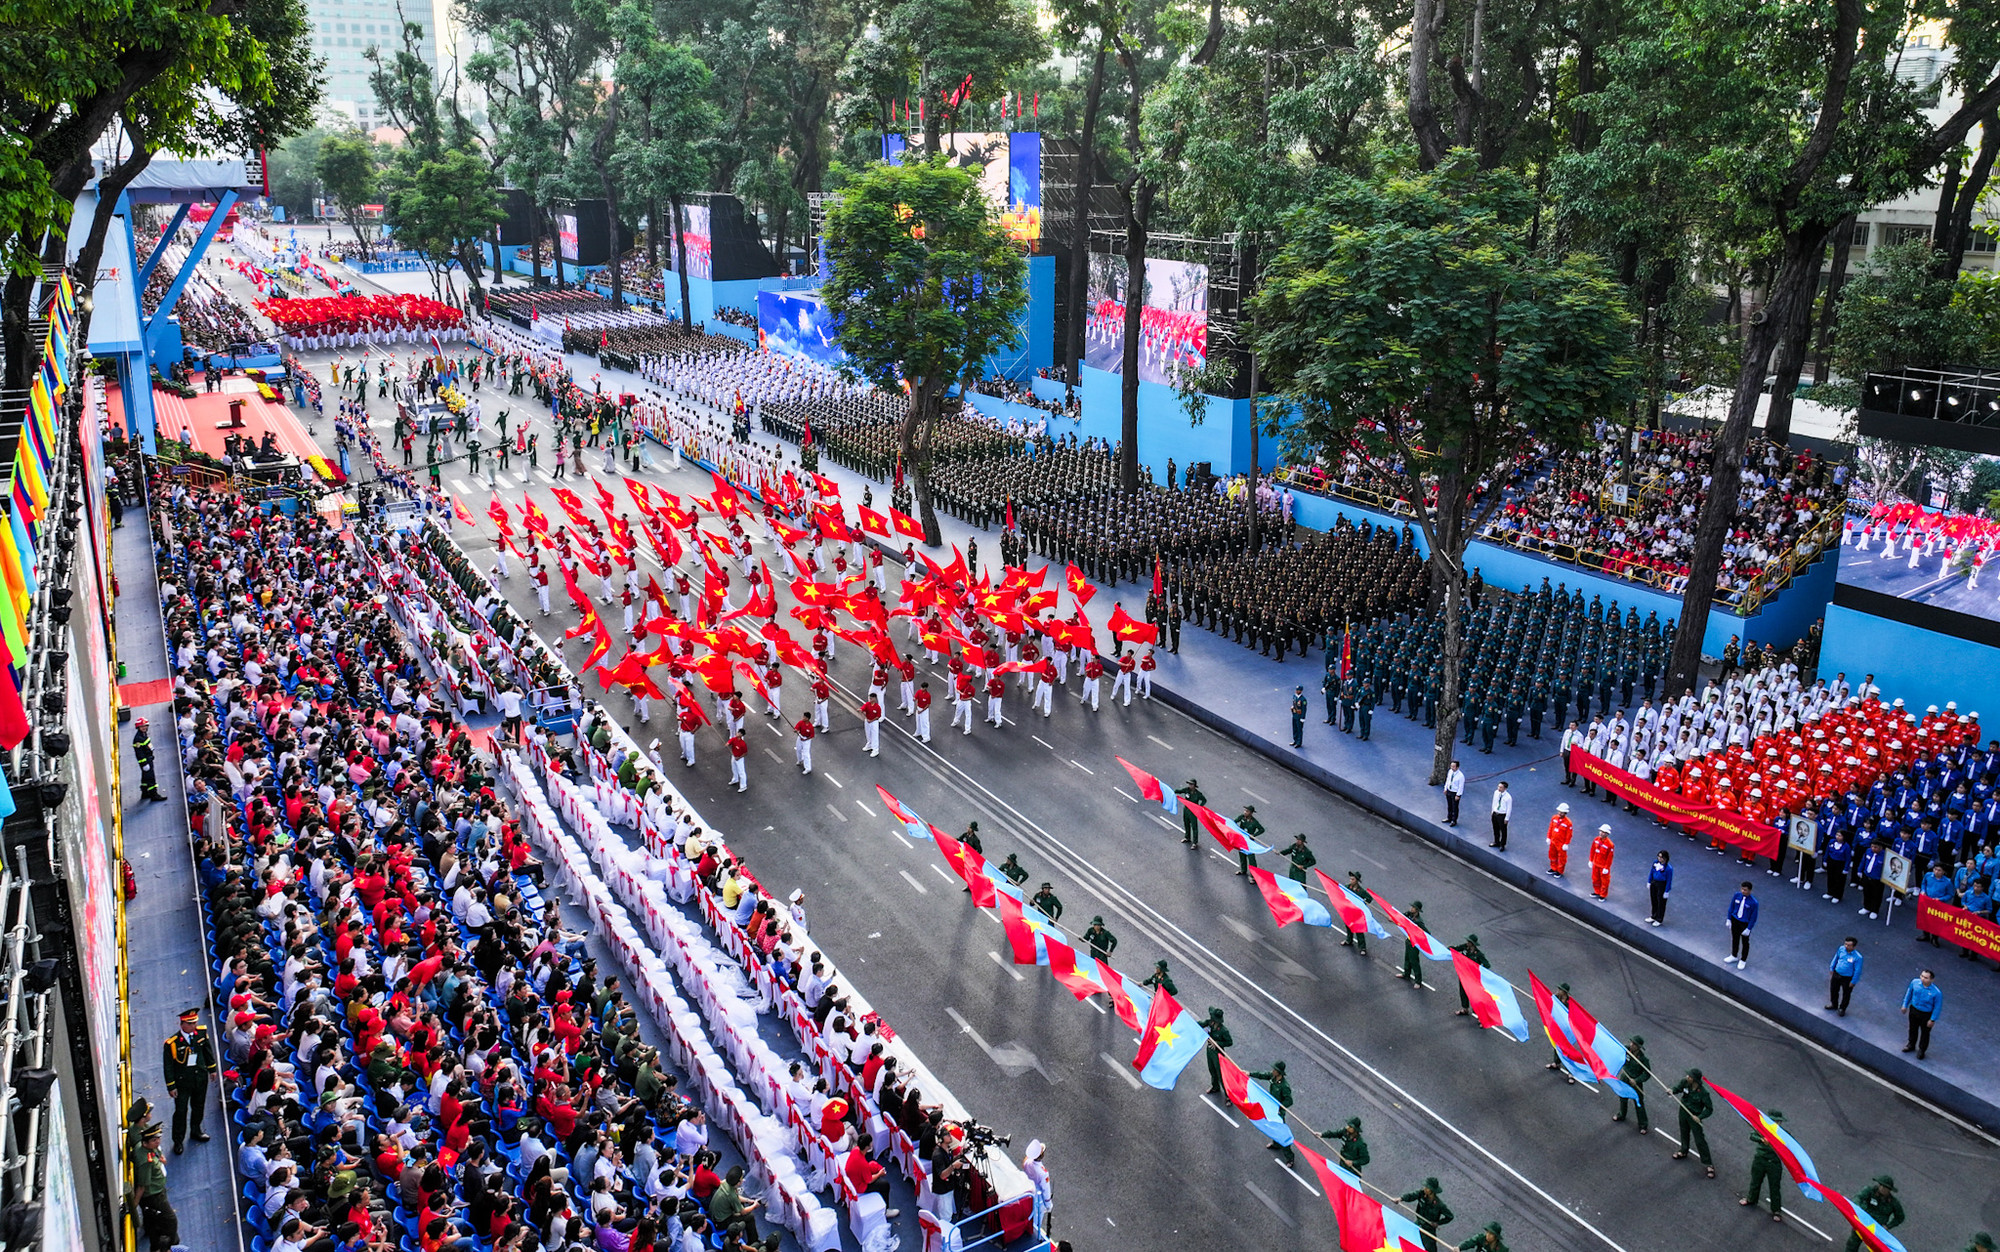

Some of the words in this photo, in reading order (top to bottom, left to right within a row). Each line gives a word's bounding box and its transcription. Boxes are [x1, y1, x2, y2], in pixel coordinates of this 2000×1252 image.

[1603, 773, 1623, 787] CỘNG
[1624, 783, 1638, 795] SẢN
[1639, 790, 1652, 801] VIỆT
[1653, 797, 1670, 809] NAM
[1717, 819, 1740, 834] MUÔN
[1741, 829, 1761, 842] NĂM
[1927, 907, 1954, 922] NHIỆT
[1955, 917, 1973, 929] LIỆT
[1954, 926, 1987, 947] THỐNG
